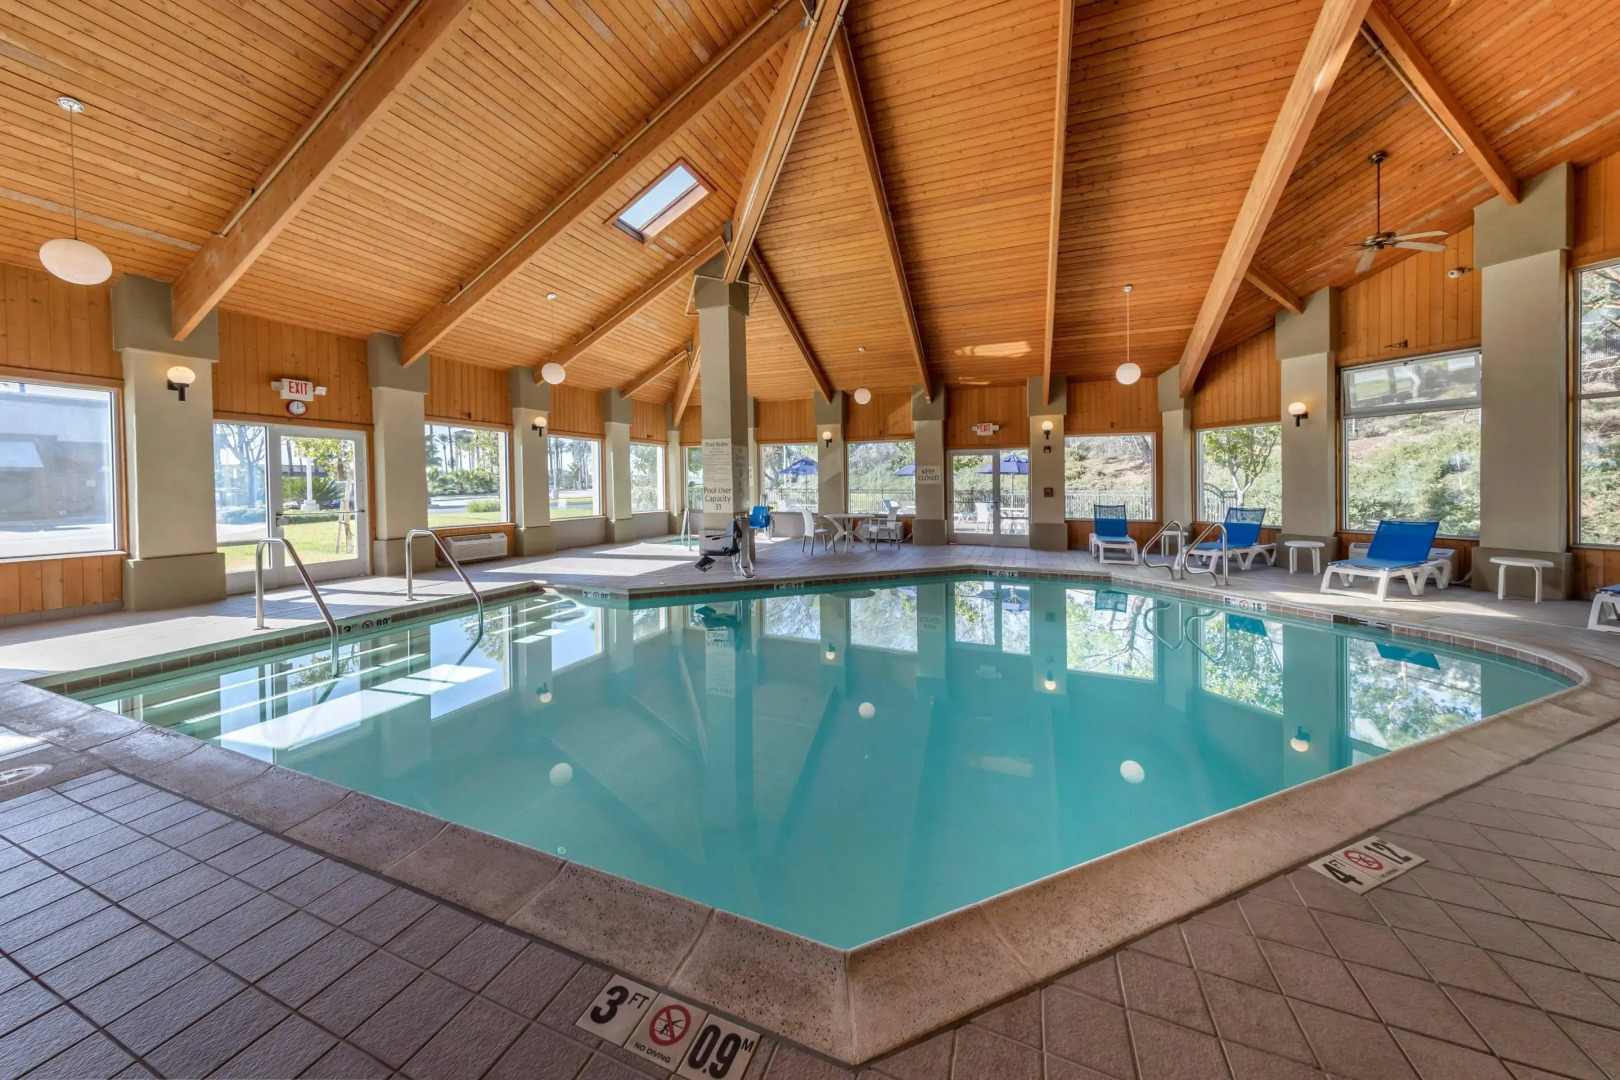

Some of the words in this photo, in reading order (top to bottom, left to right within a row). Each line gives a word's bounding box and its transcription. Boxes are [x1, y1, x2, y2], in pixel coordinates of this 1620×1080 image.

[288, 381, 308, 395] EXIT
[979, 424, 990, 432] EXIT
[705, 494, 731, 503] Capacity
[1328, 860, 1346, 869] FT
[1322, 863, 1364, 885] 4
[590, 985, 629, 1024] 3
[628, 992, 649, 1009] FT
[741, 1038, 754, 1052] M
[634, 1042, 646, 1052] NO
[646, 1048, 671, 1064] DIVING
